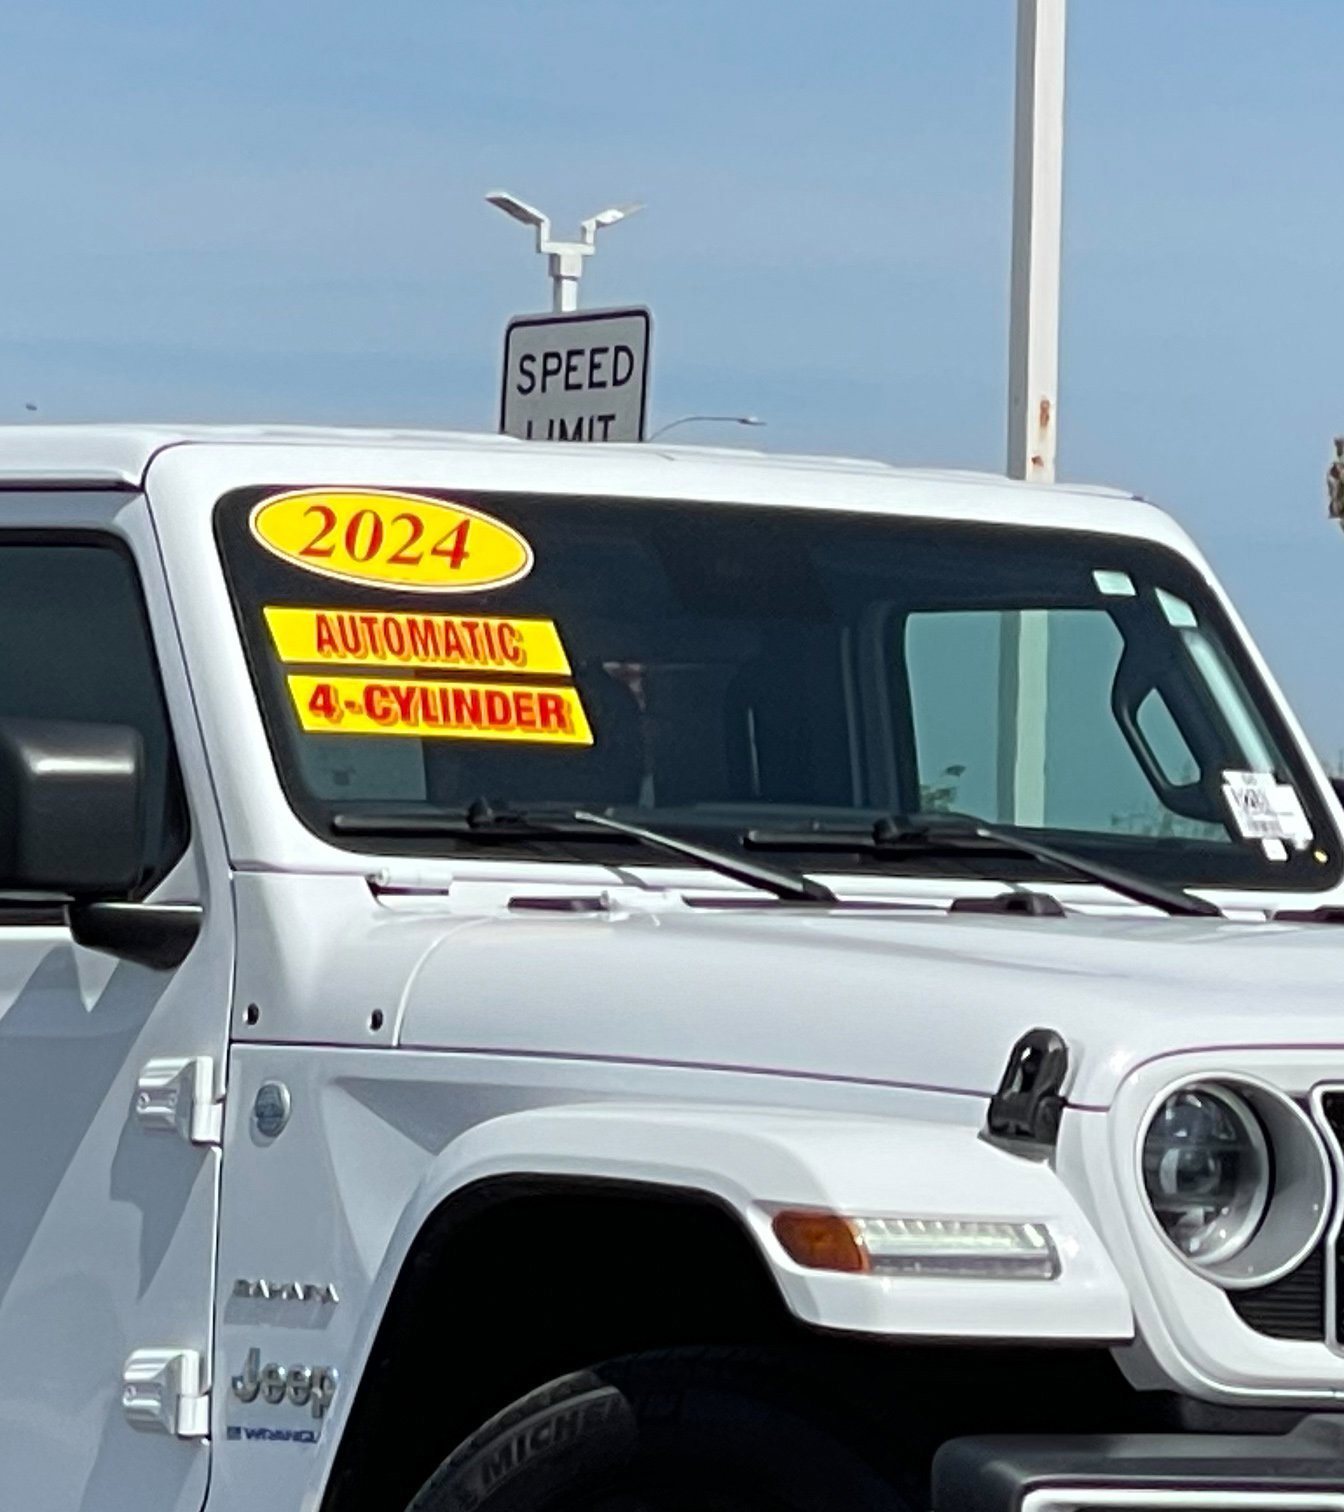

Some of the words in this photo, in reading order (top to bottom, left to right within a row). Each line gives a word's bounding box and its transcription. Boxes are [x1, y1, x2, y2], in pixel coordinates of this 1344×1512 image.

[516, 344, 634, 395] SPEED
[299, 504, 472, 570] 2024
[314, 612, 527, 667] AUTOMATIC
[308, 682, 574, 734] 4-CYLINDER
[232, 1347, 340, 1419] Jeep
